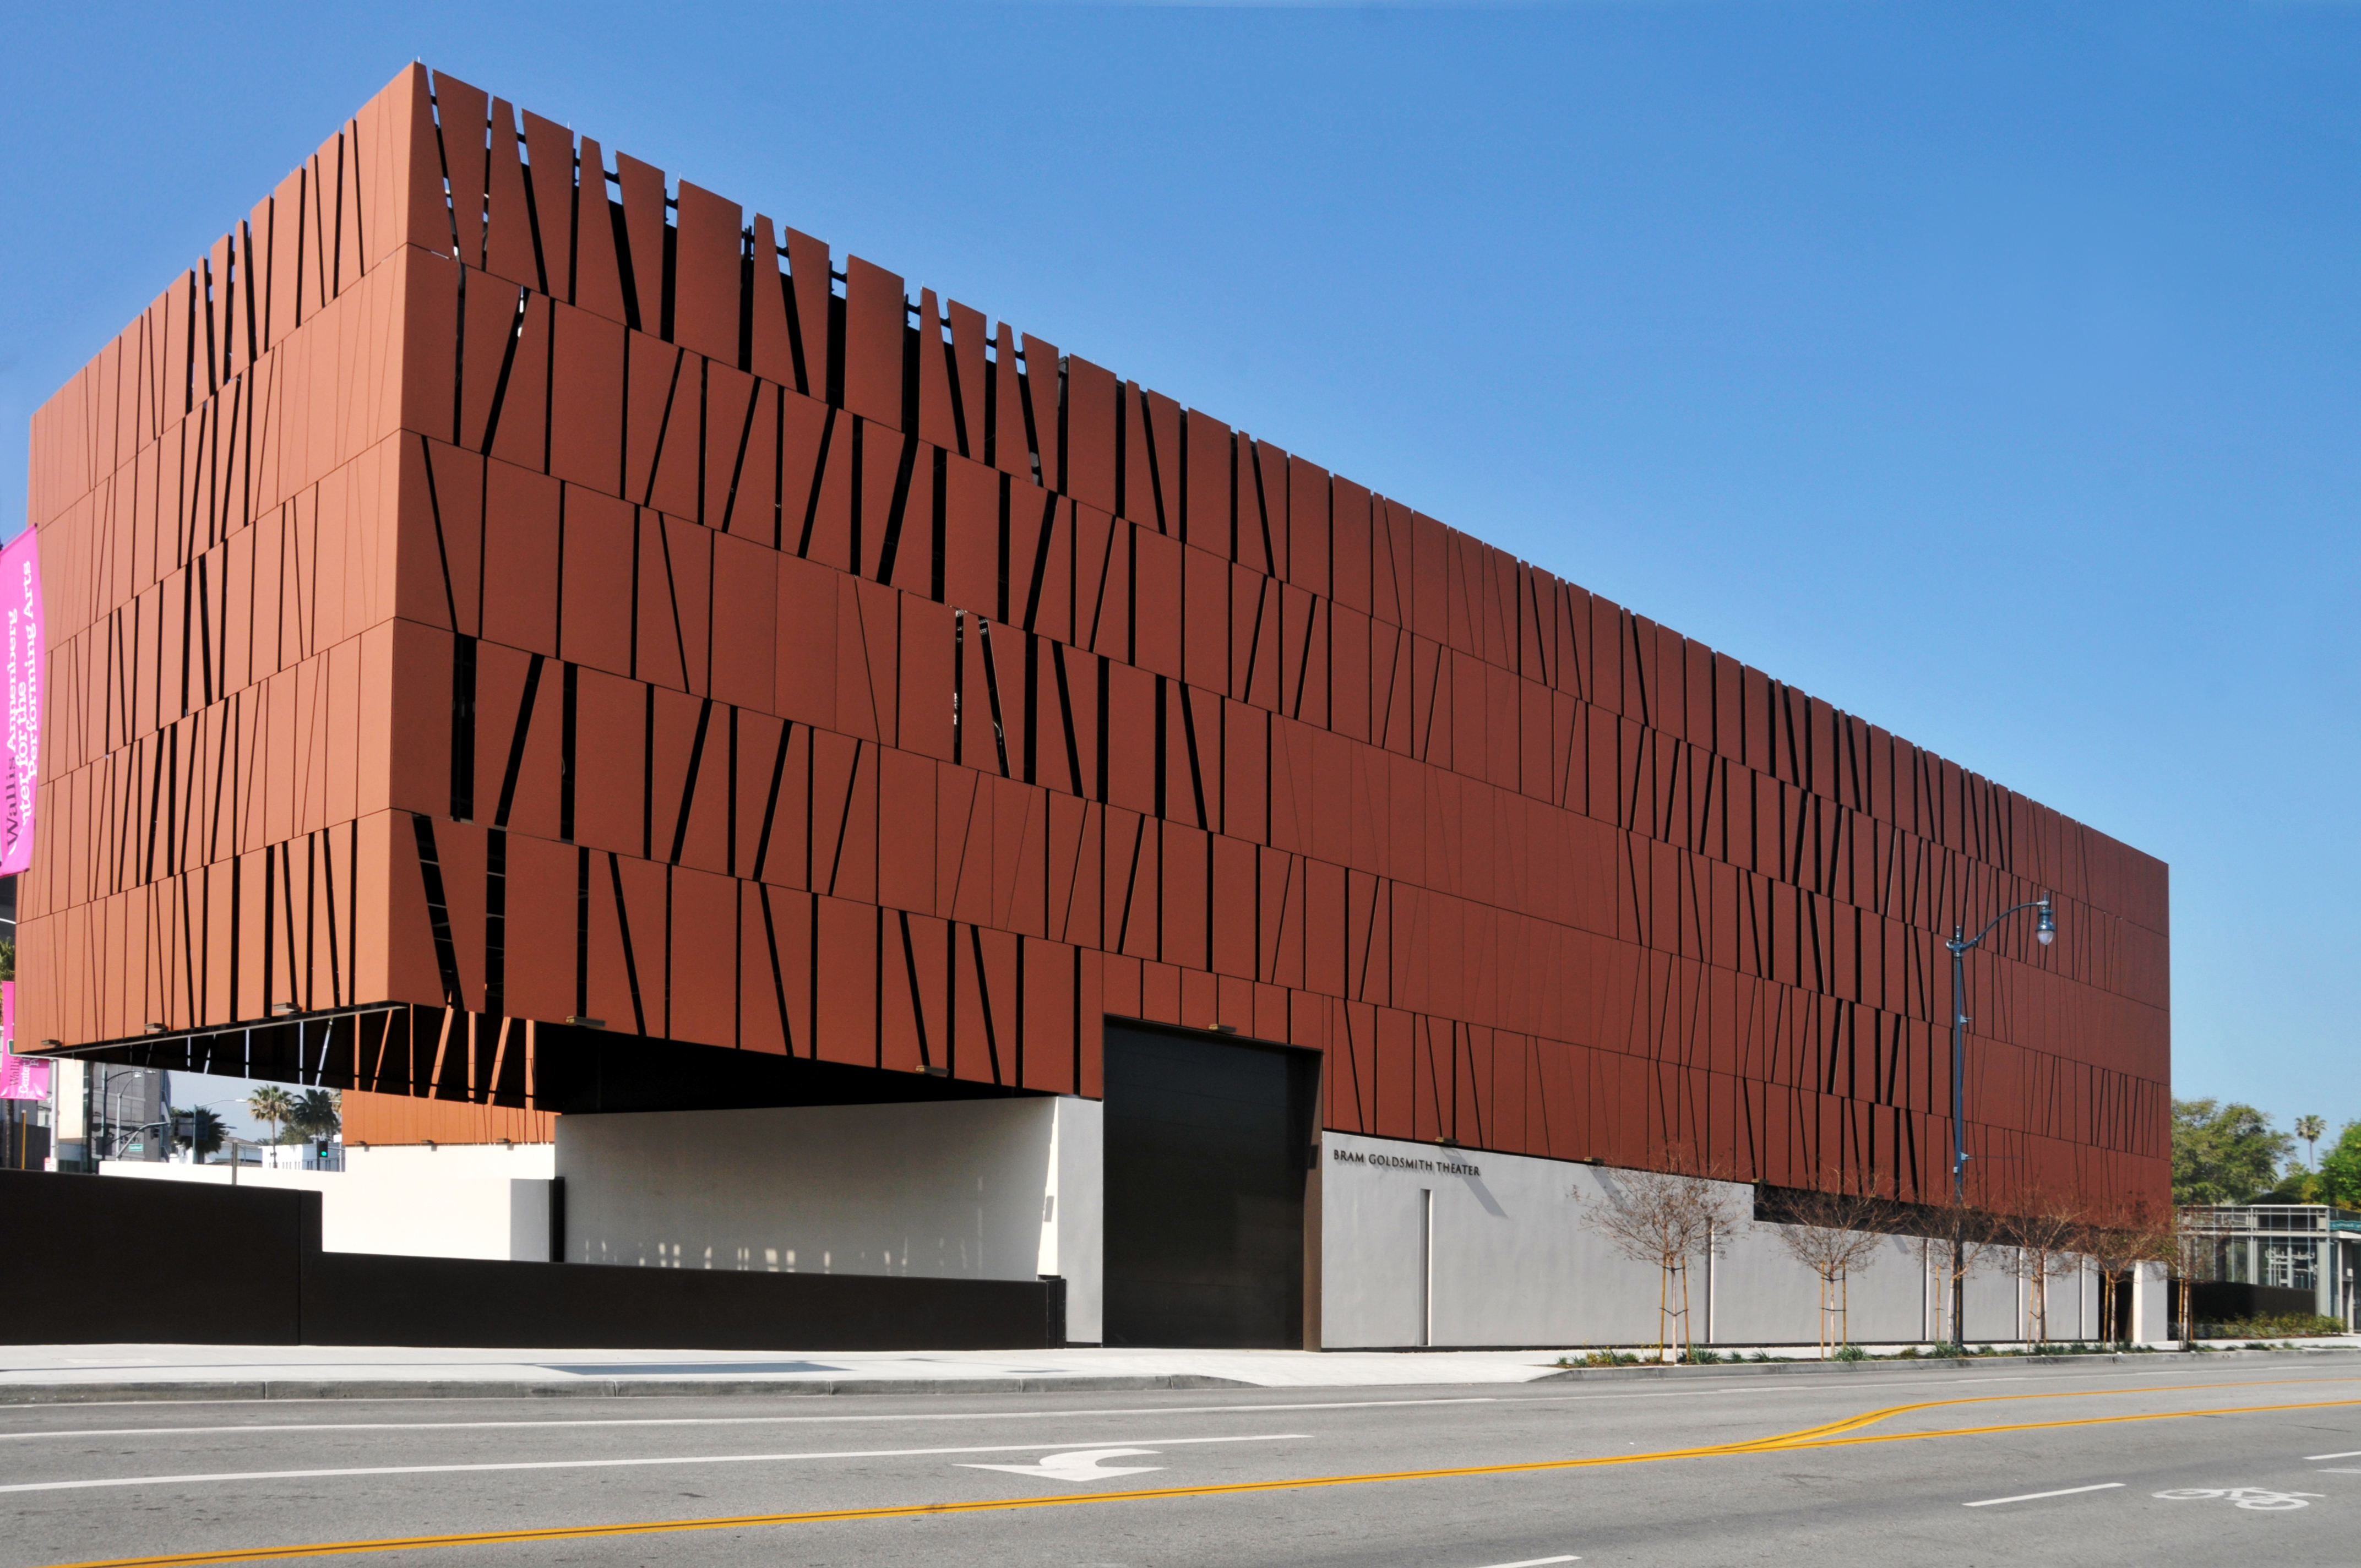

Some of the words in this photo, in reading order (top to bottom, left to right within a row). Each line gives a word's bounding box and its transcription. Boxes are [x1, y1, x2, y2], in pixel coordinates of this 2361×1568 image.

[23, 560, 33, 619] Arts
[7, 608, 18, 753] Annenberg
[15, 682, 26, 726] the
[24, 623, 37, 780] Performing
[15, 729, 28, 768] for
[6, 756, 18, 848] Wallis
[18, 1063, 30, 1093] Center
[1334, 1149, 1364, 1163] BRAM
[1368, 1154, 1432, 1170] GOLDSMITH
[1436, 1162, 1479, 1176] THEATER
